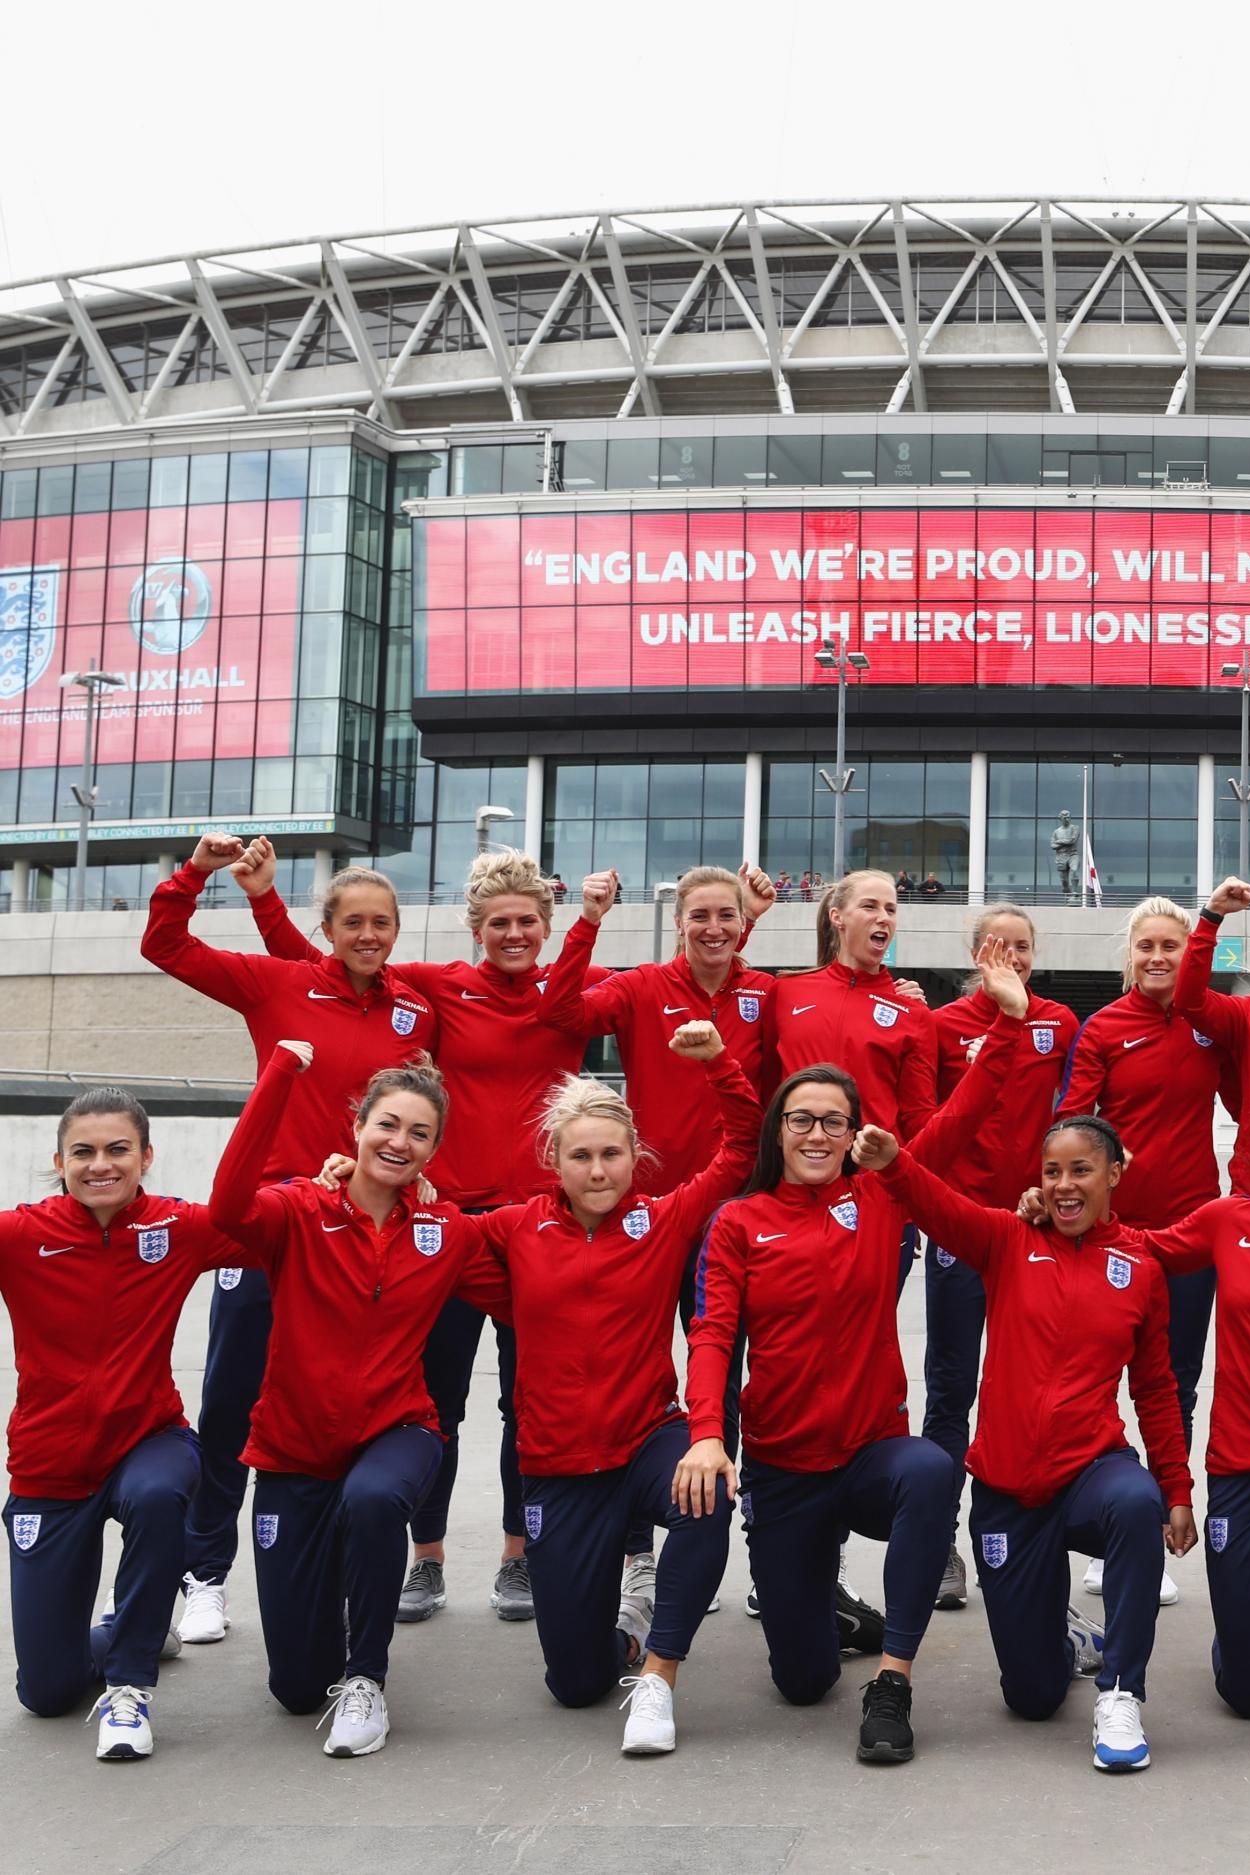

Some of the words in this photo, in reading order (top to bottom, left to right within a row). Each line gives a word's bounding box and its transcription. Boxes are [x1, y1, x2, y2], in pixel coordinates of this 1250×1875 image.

[525, 549, 756, 586] “ENGLAND
[927, 548, 1098, 589] PROUD,
[1112, 549, 1226, 583] WILL
[640, 611, 850, 646] UNLEASH
[864, 611, 1034, 651] FIERCE,
[25, 704, 88, 724] ENGLAND
[93, 702, 130, 720] TEAM
[134, 698, 204, 718] SPONSOR
[111, 826, 163, 837] CONNECTED
[198, 823, 242, 833] WEMBLEY
[244, 822, 298, 832] CONNECTED
[299, 821, 311, 831] BY
[313, 821, 324, 830] EE
